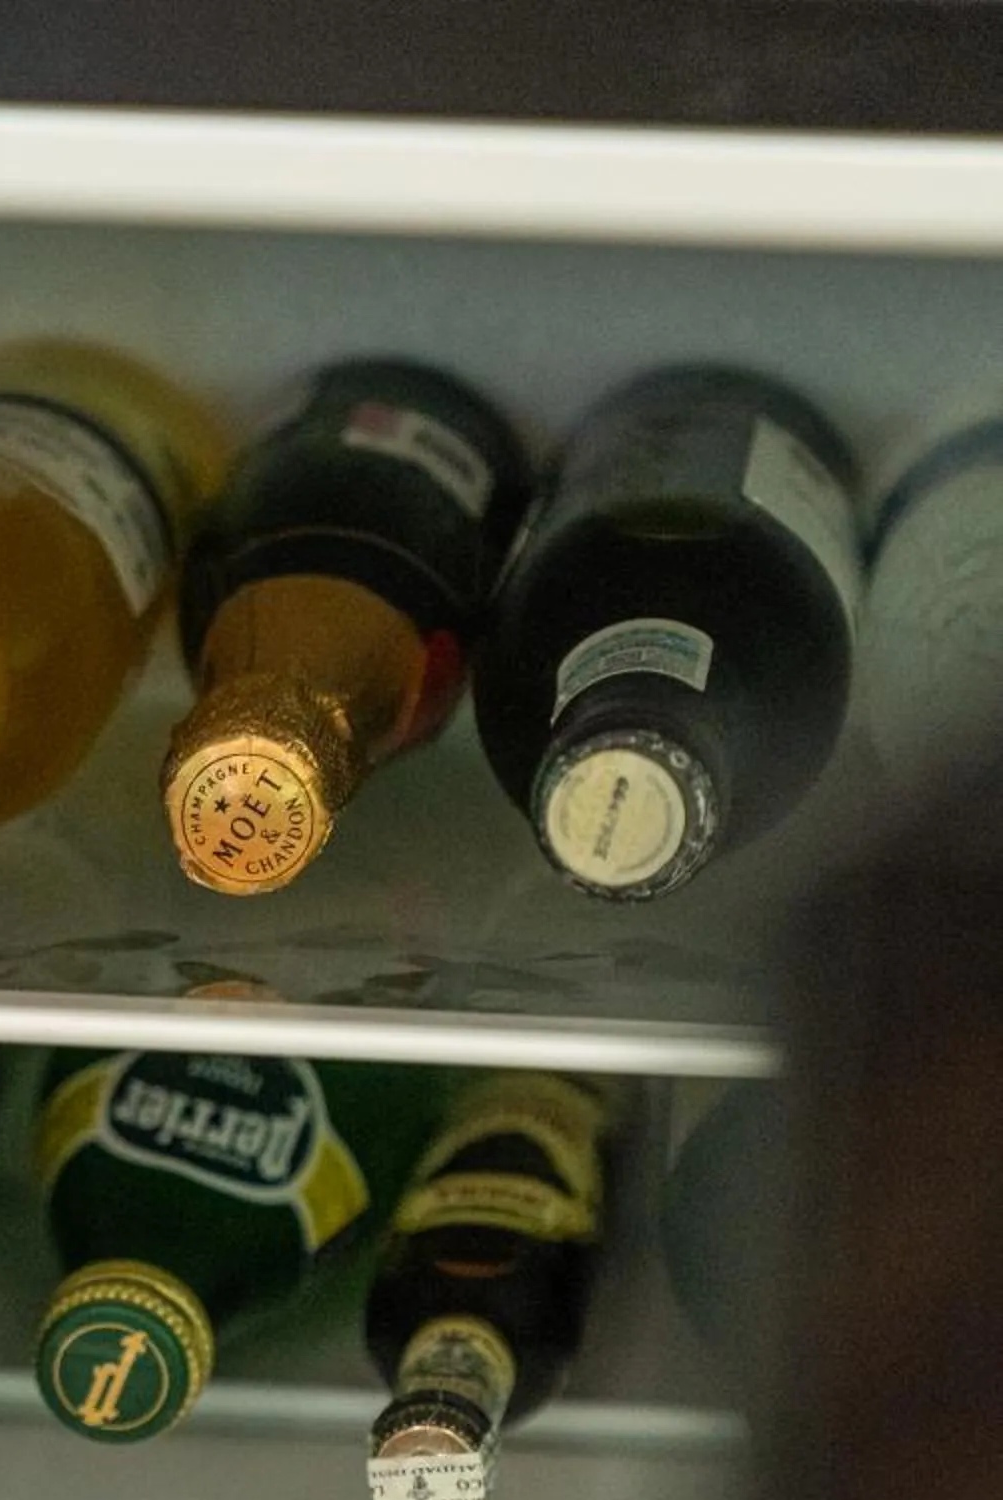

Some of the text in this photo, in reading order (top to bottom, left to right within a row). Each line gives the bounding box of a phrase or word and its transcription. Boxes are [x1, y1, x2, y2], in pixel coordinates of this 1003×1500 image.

[190, 762, 251, 846] CHAMPAGNE
[245, 797, 306, 876] CHANDON
[260, 828, 282, 845] &
